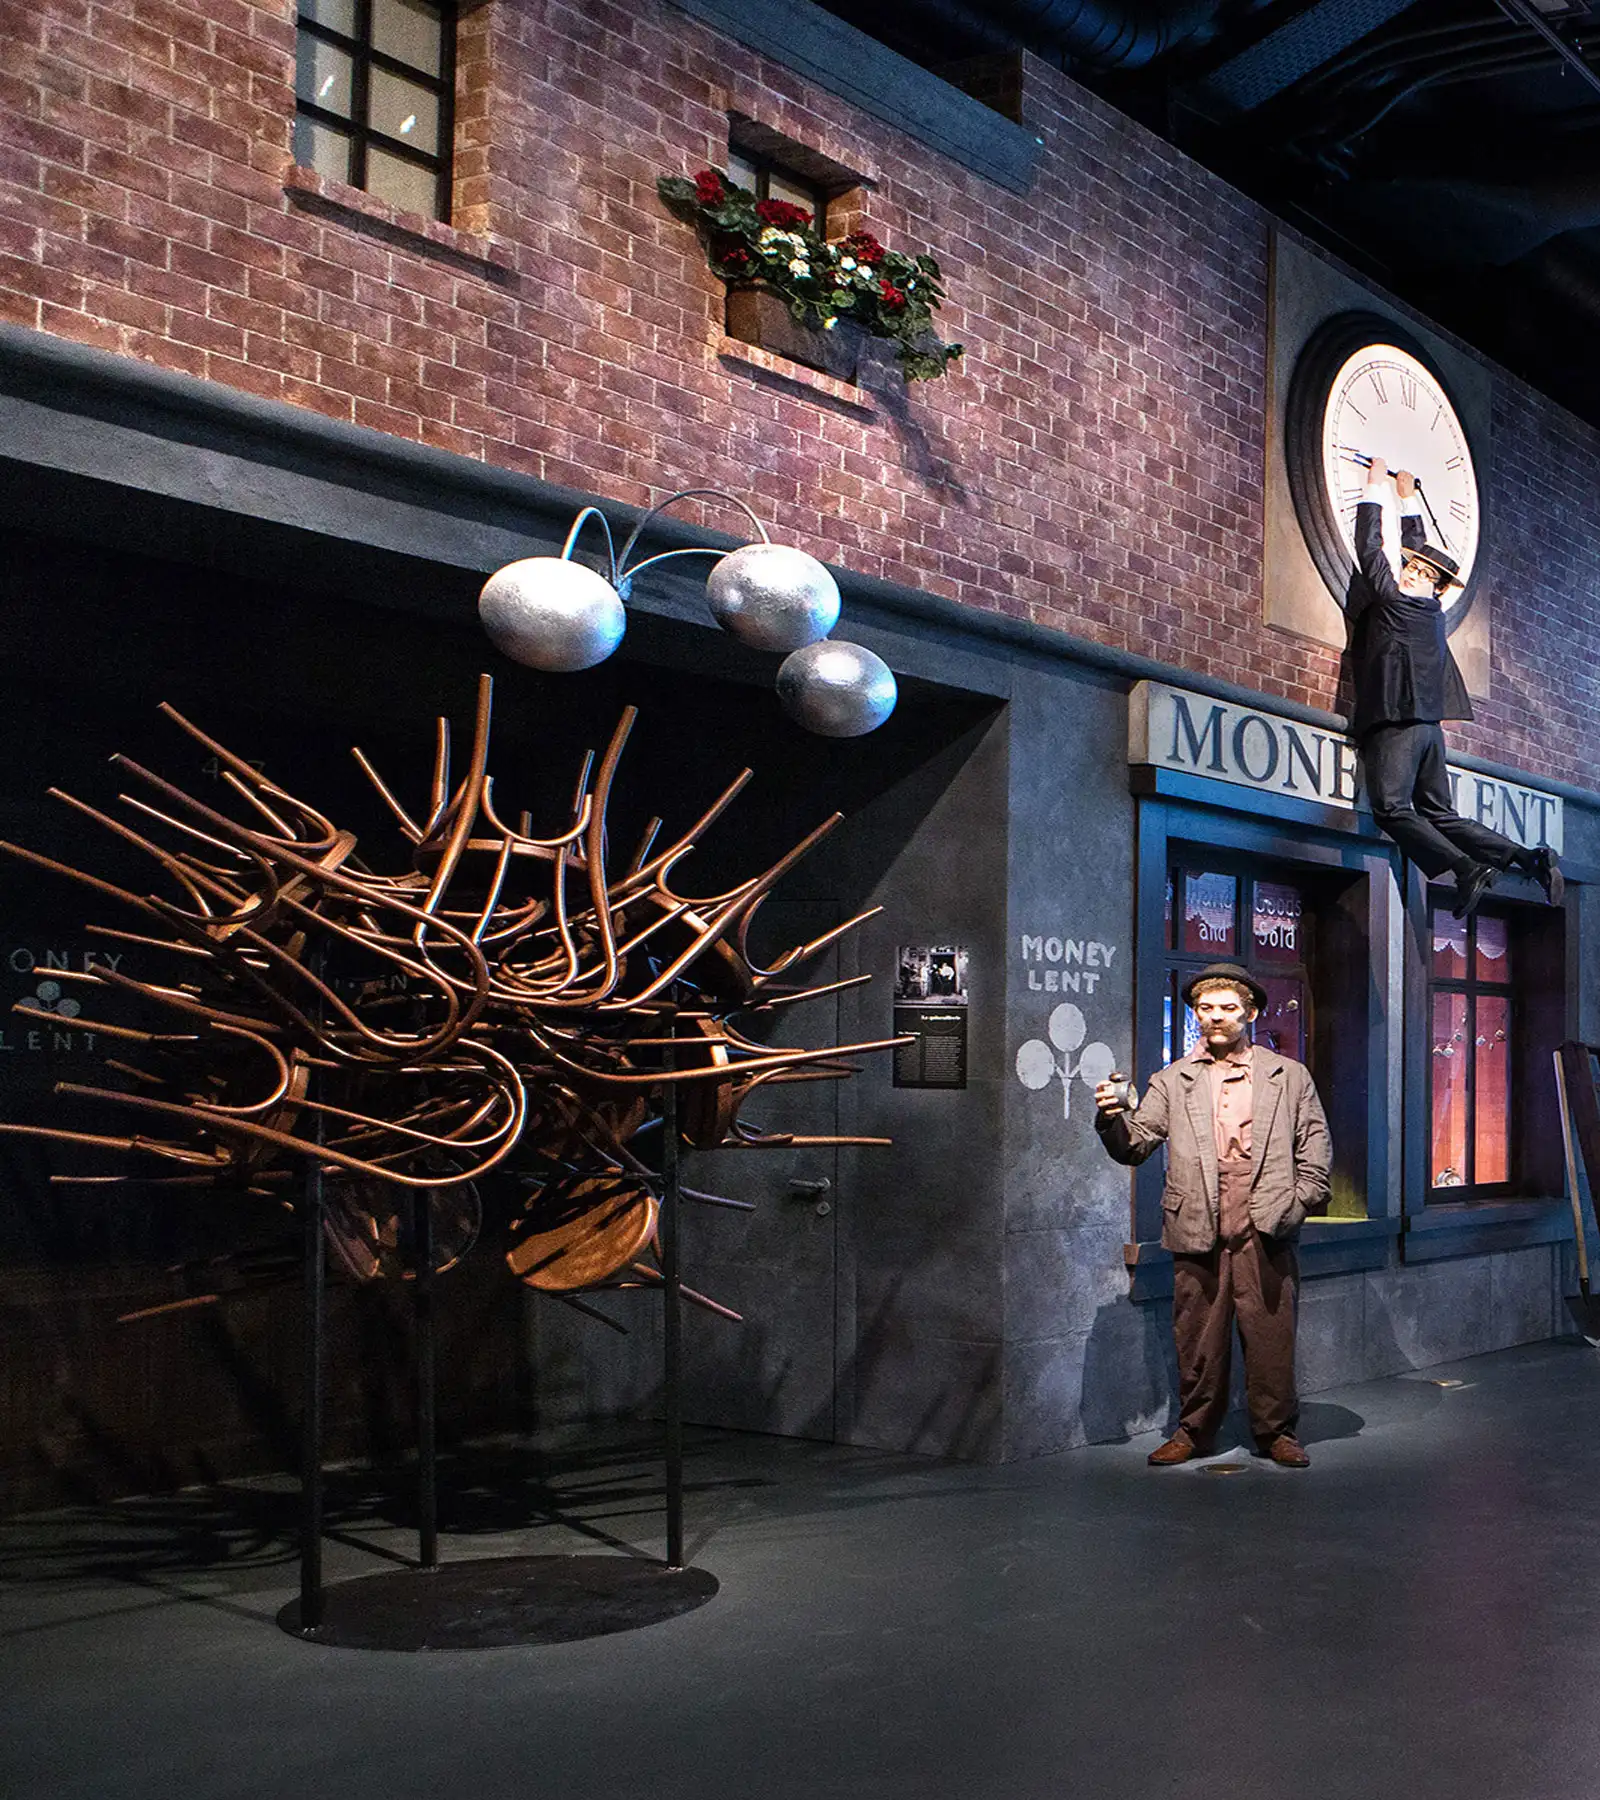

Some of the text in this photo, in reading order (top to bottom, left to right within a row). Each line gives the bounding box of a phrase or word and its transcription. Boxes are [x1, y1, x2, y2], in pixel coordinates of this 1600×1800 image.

[1166, 693, 1360, 802] MONE
[1199, 920, 1227, 943] and
[10, 948, 123, 973] ONEY
[1022, 934, 1116, 968] MONEY
[1028, 970, 1100, 995] LENT
[0, 1030, 97, 1051] LENT
